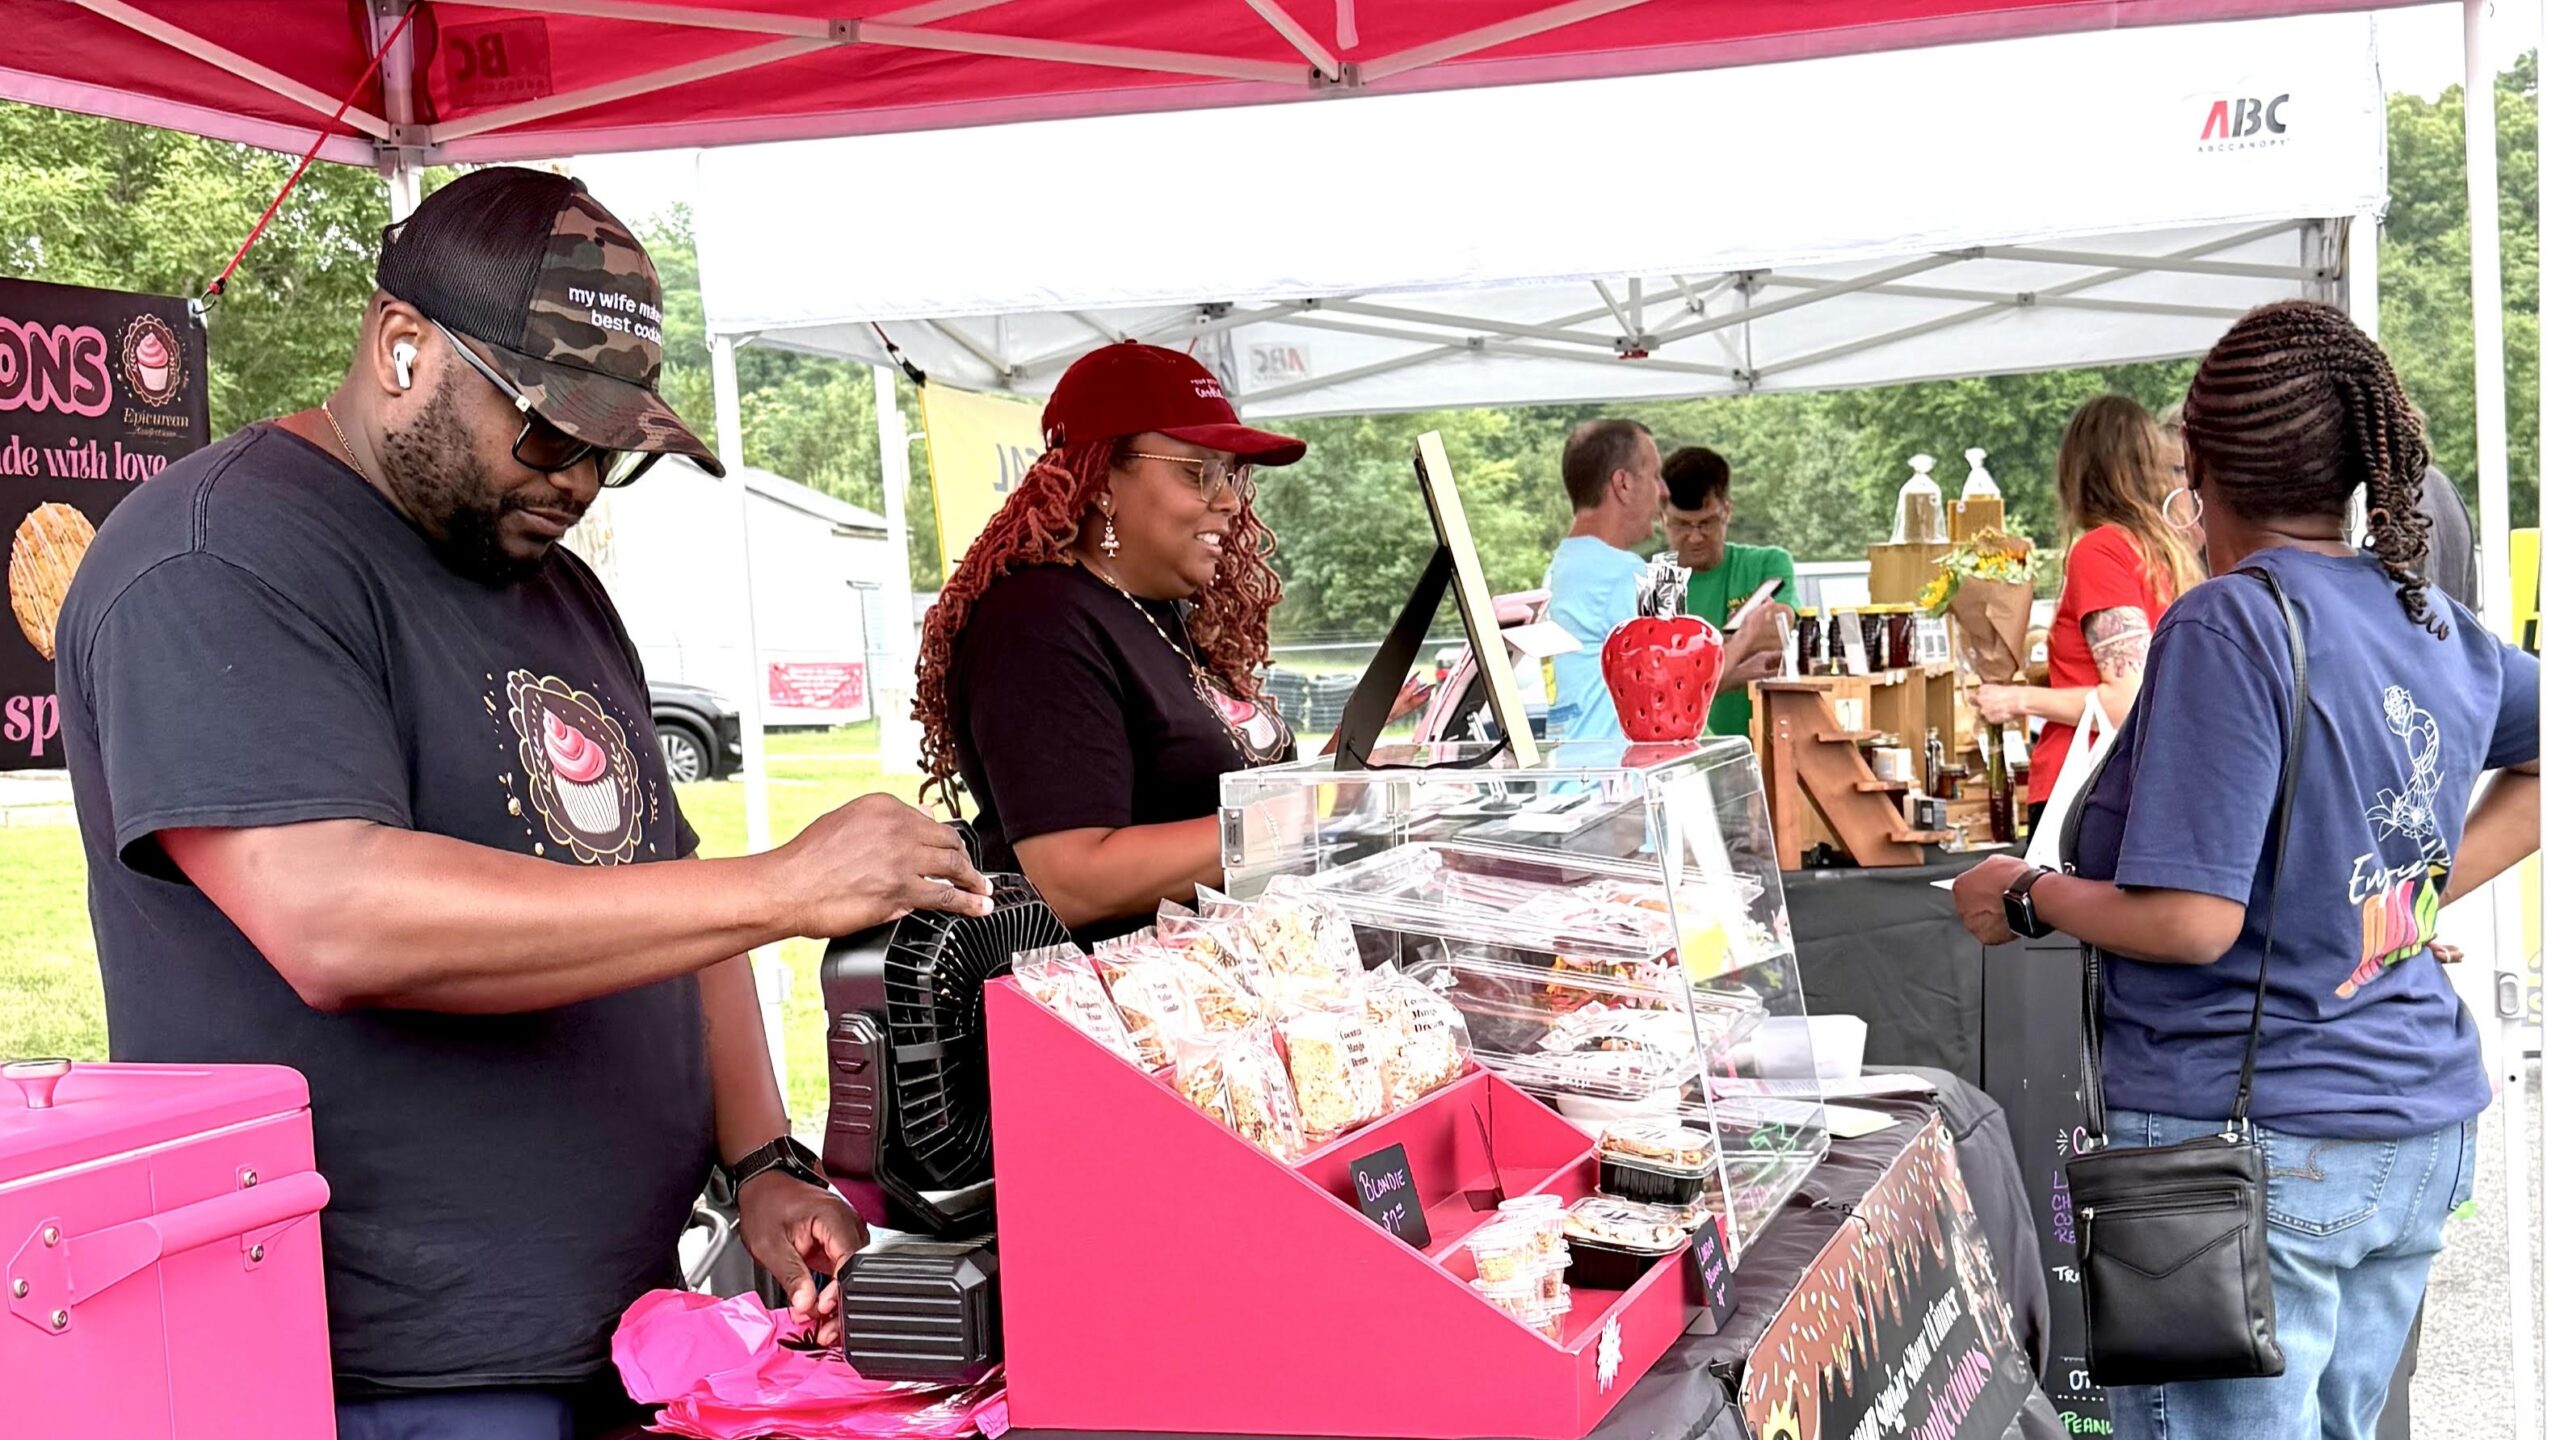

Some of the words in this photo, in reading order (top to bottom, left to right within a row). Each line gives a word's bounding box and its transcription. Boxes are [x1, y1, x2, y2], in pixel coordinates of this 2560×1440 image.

[2200, 94, 2290, 140] ABC
[569, 287, 595, 307] my
[600, 292, 636, 323] wife
[591, 309, 631, 333] best
[44, 436, 108, 480] with
[1359, 1169, 1406, 1202] BLONDIE
[1922, 1286, 1962, 1352] Winner
